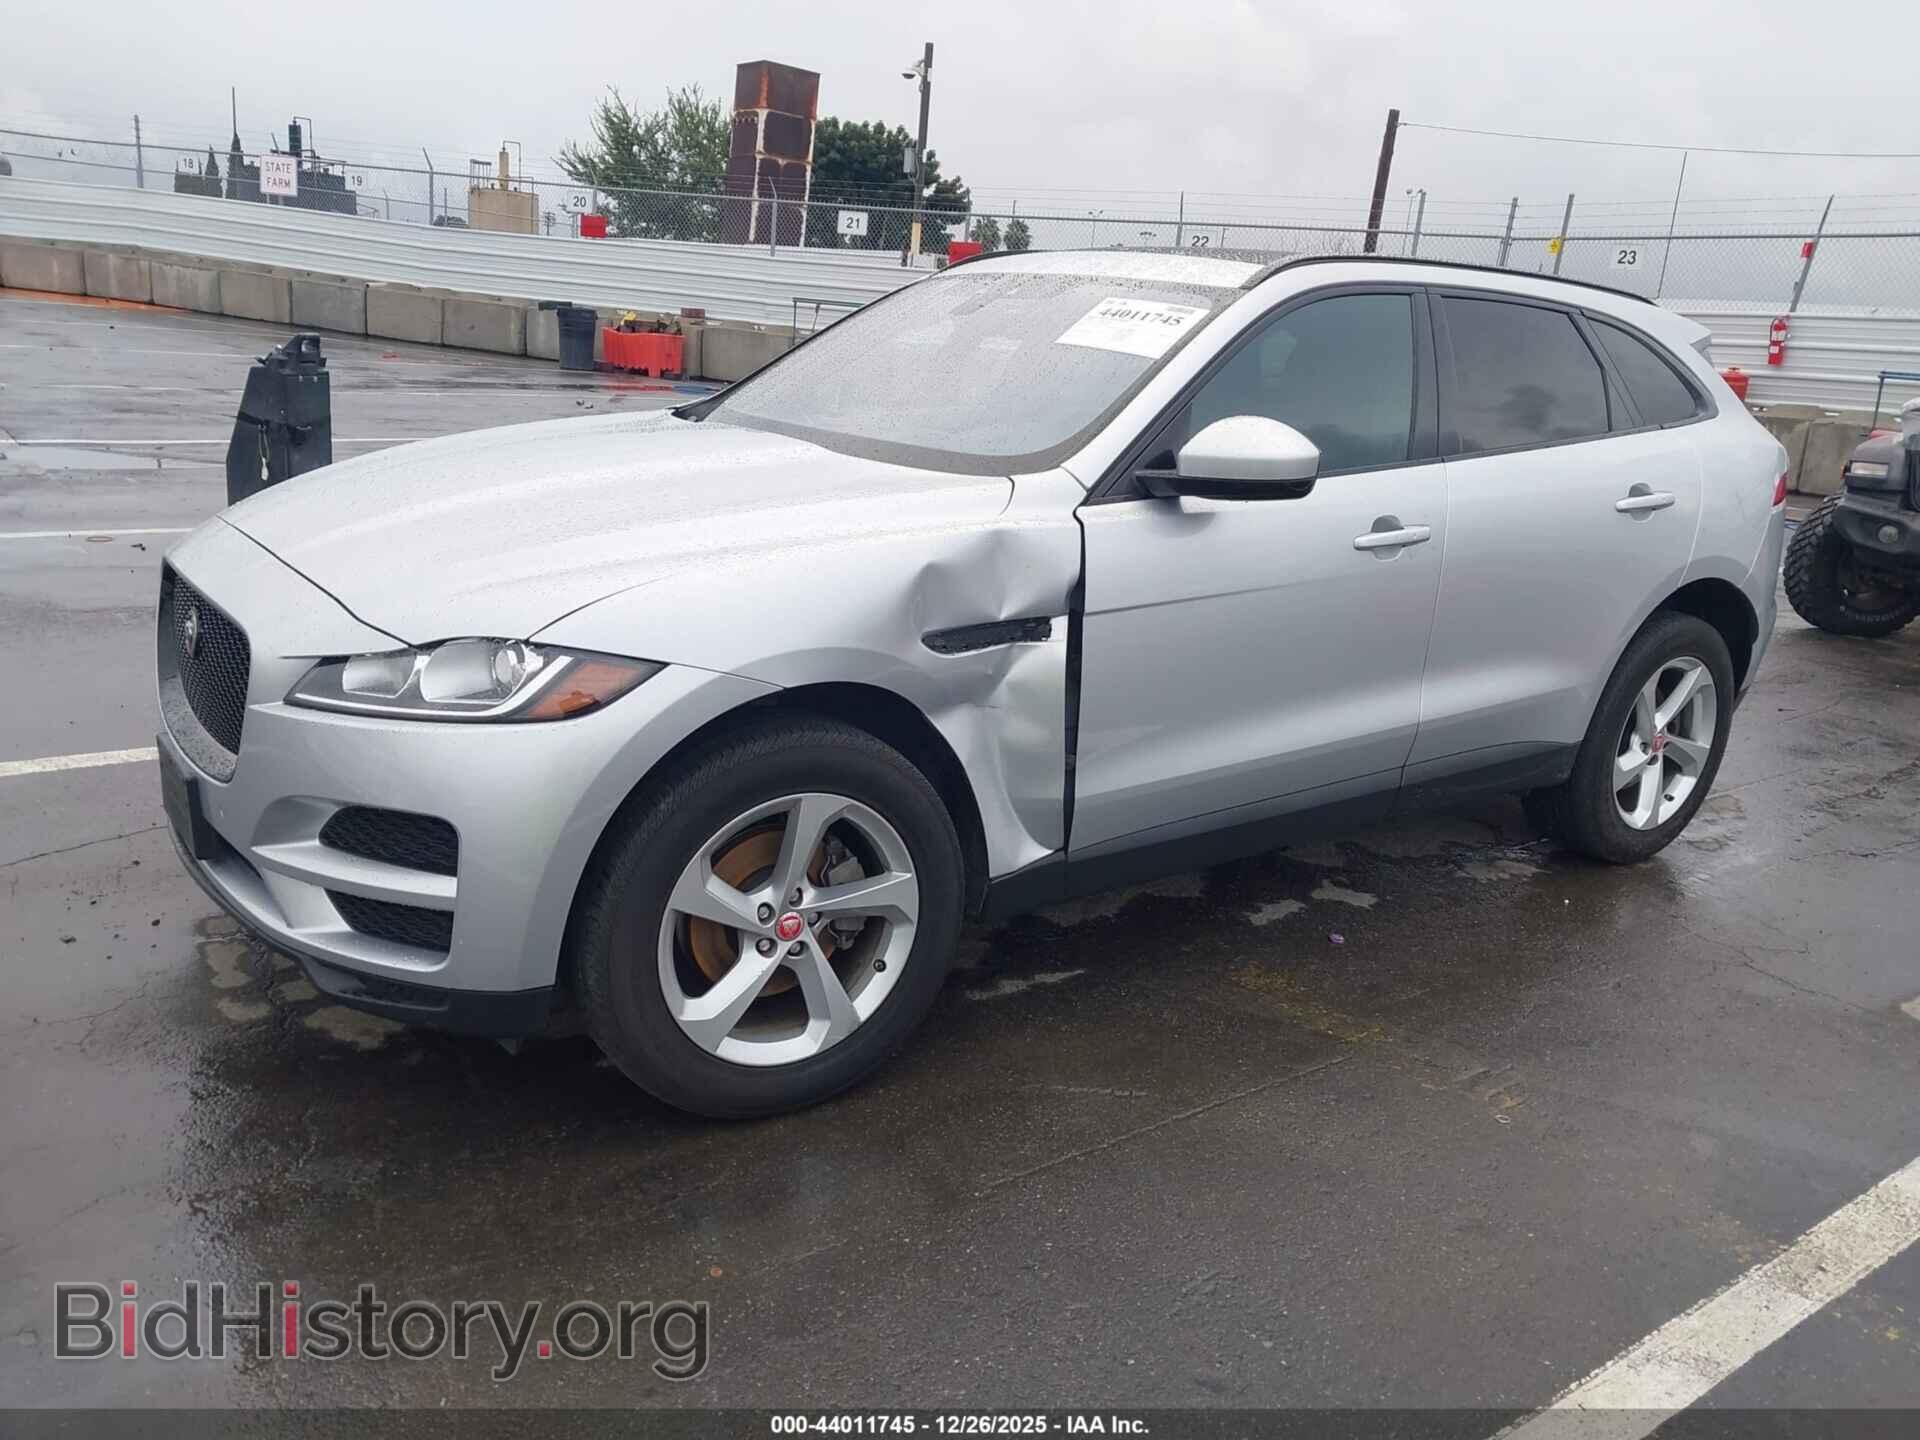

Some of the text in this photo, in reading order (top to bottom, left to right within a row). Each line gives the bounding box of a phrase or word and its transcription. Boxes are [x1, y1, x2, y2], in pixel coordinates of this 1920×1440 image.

[183, 158, 194, 169] 18
[265, 160, 292, 174] STATE
[266, 176, 291, 189] FARM
[351, 175, 363, 186] 19
[573, 196, 587, 207] 20
[846, 217, 860, 229] 21
[1191, 235, 1209, 248] 22
[1617, 250, 1637, 265] 23
[1100, 308, 1185, 326] 44011745
